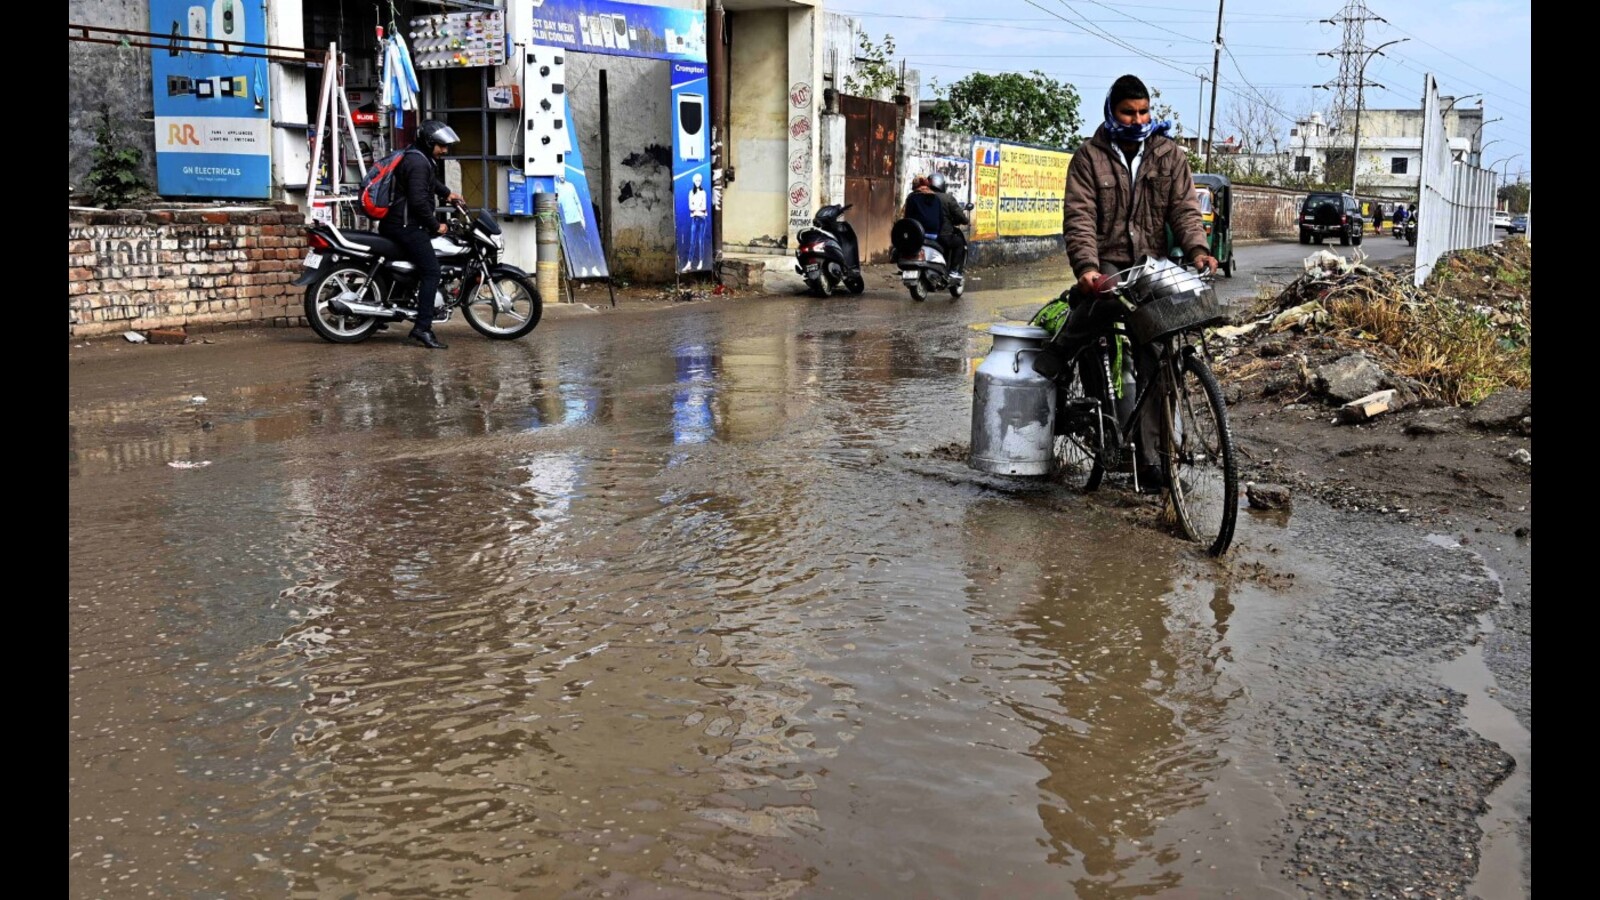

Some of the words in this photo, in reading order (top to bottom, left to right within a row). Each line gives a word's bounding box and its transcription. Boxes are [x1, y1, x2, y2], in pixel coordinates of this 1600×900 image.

[543, 19, 556, 30] DAY
[548, 31, 576, 44] COOLING
[674, 64, 705, 74] Crompton
[167, 124, 200, 145] RR
[182, 166, 193, 175] GN
[194, 166, 241, 176] ELECTRICALS
